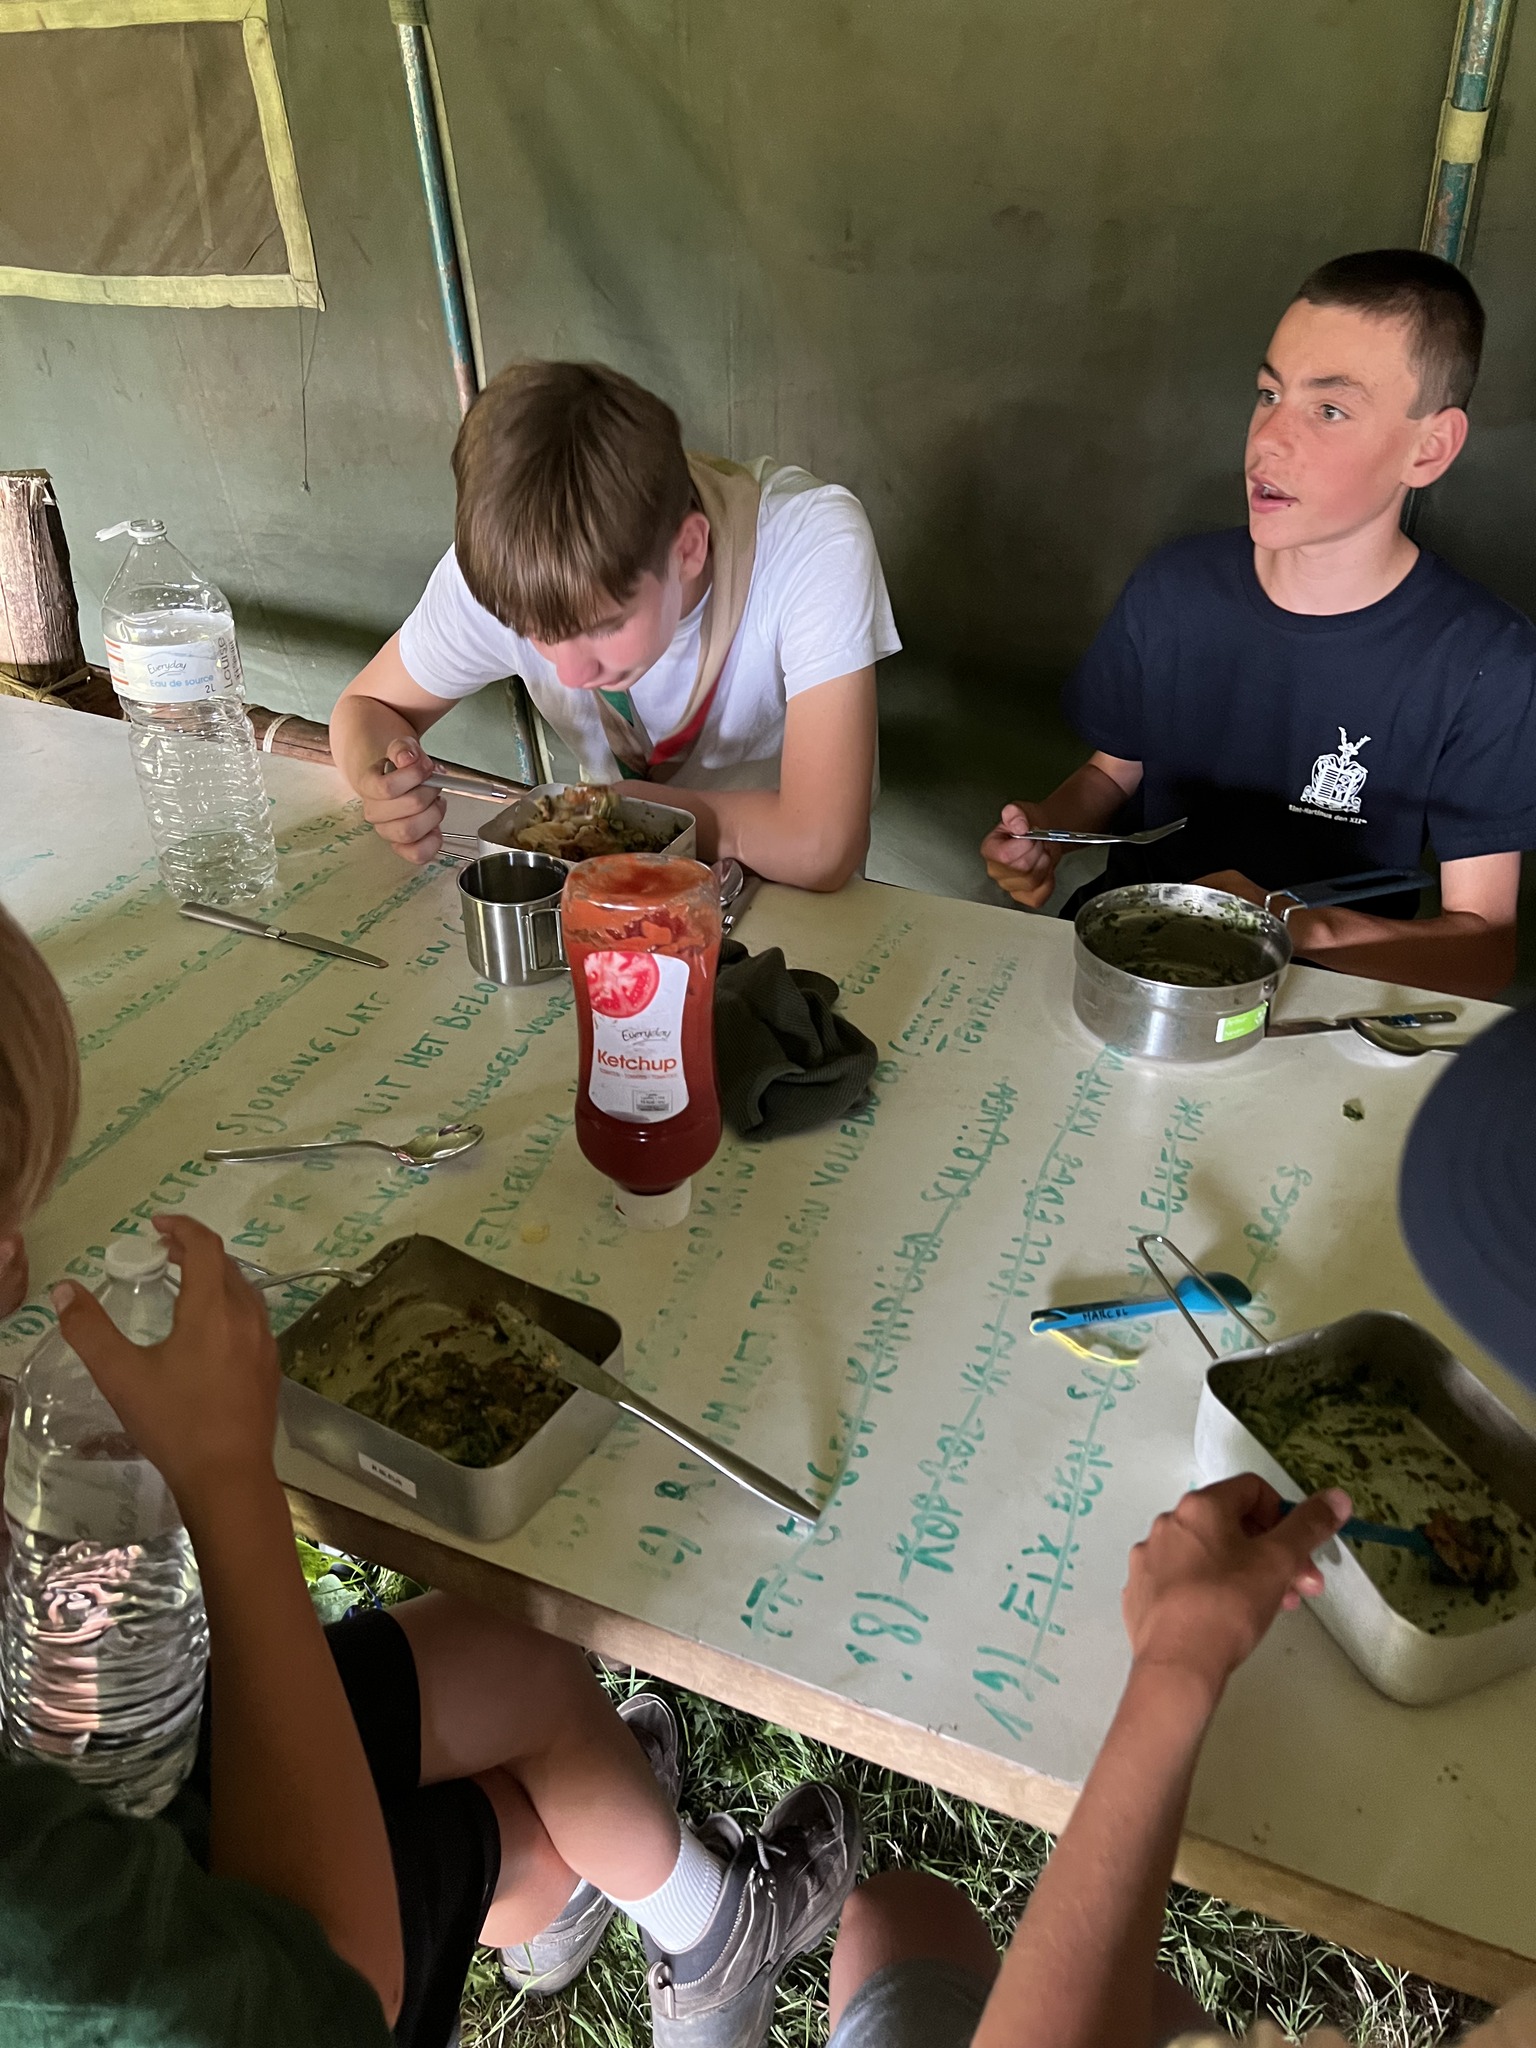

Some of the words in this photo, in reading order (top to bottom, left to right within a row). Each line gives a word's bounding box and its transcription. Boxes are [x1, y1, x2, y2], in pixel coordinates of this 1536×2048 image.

[147, 660, 187, 674] Everyday
[169, 678, 183, 688] de
[184, 673, 214, 686] source
[621, 1028, 672, 1042] Everyday
[395, 1032, 450, 1069] HET
[597, 1048, 678, 1073] Ketchup
